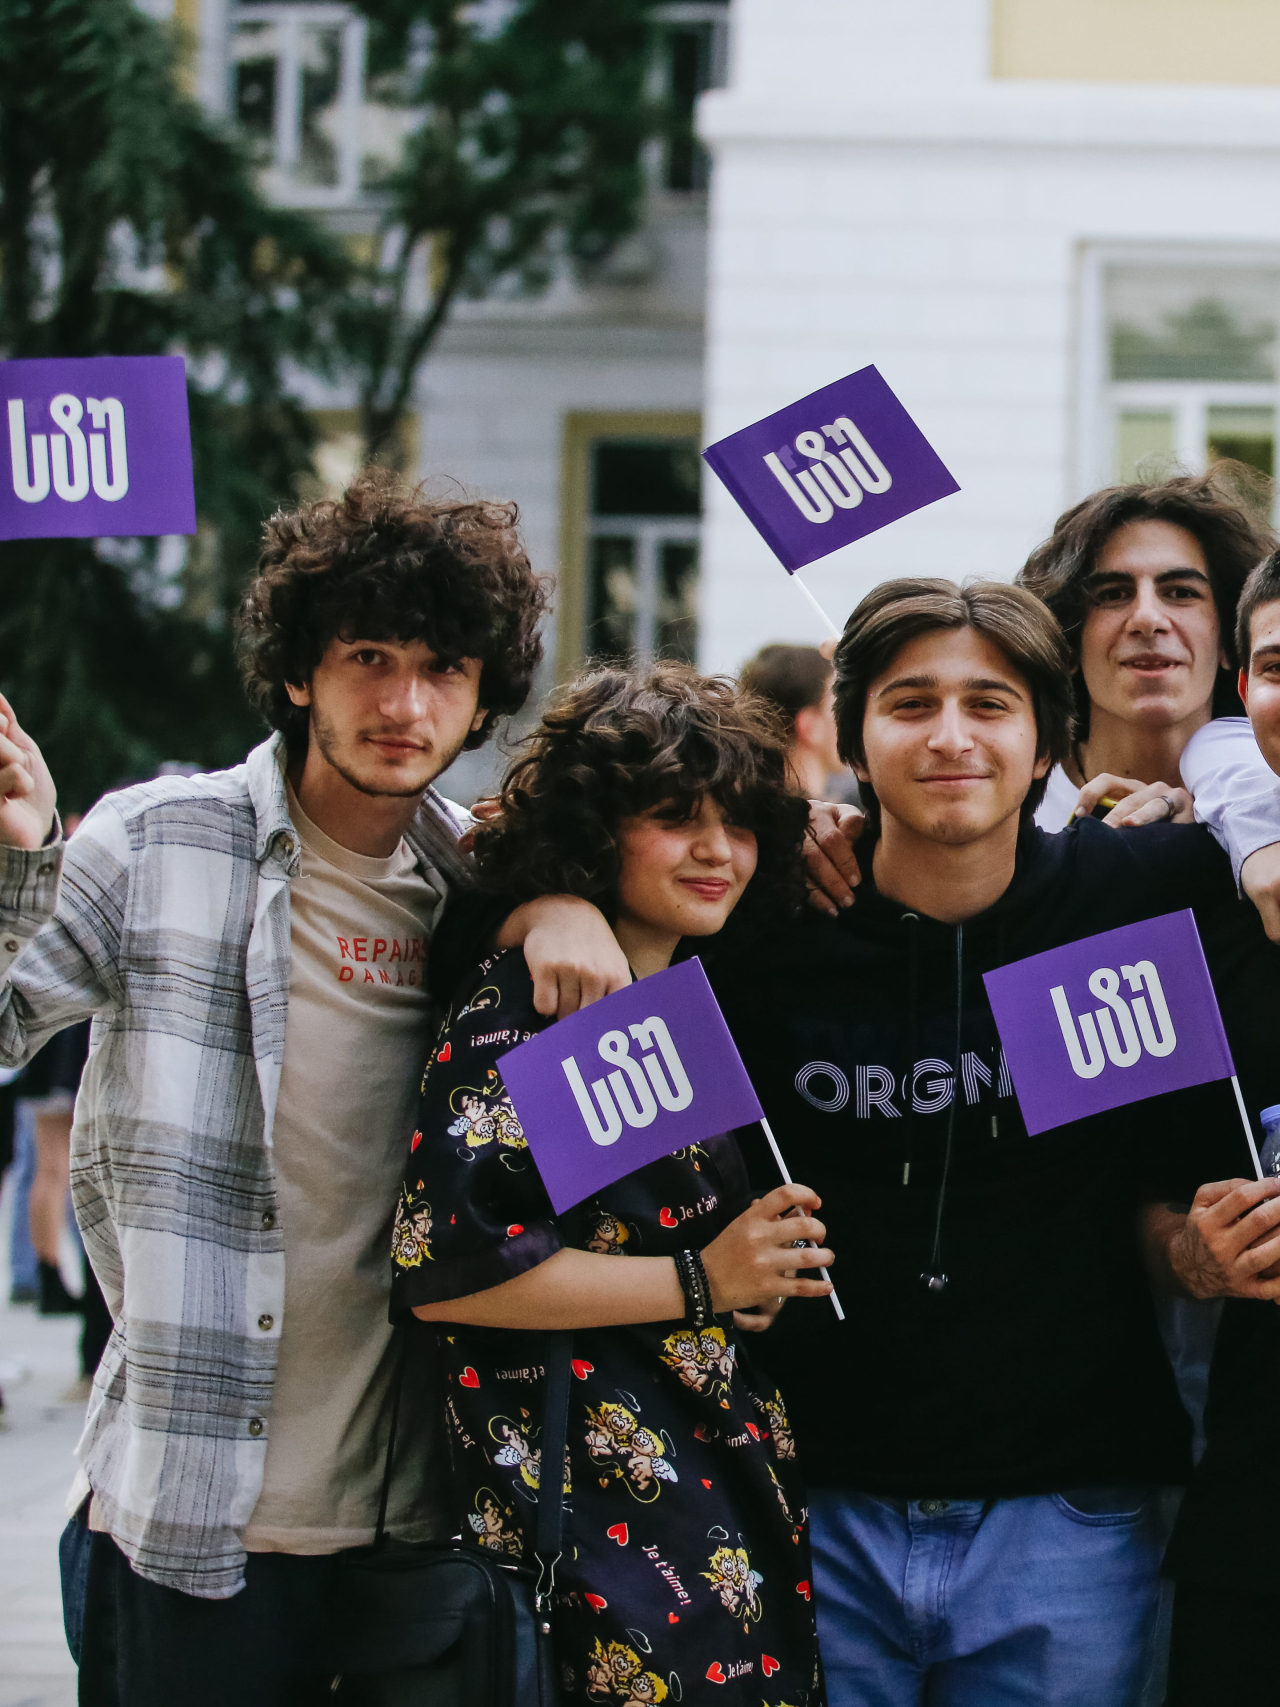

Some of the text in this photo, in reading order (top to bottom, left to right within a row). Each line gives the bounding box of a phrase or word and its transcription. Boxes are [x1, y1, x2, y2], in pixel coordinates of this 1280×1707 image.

[338, 966, 420, 986] DAMAG
[470, 1029, 519, 1047] t'aime!
[679, 1206, 695, 1221] Je
[725, 1432, 752, 1448] ime!
[641, 1545, 692, 1606] Je t'aime!
[728, 1663, 736, 1679] Je
